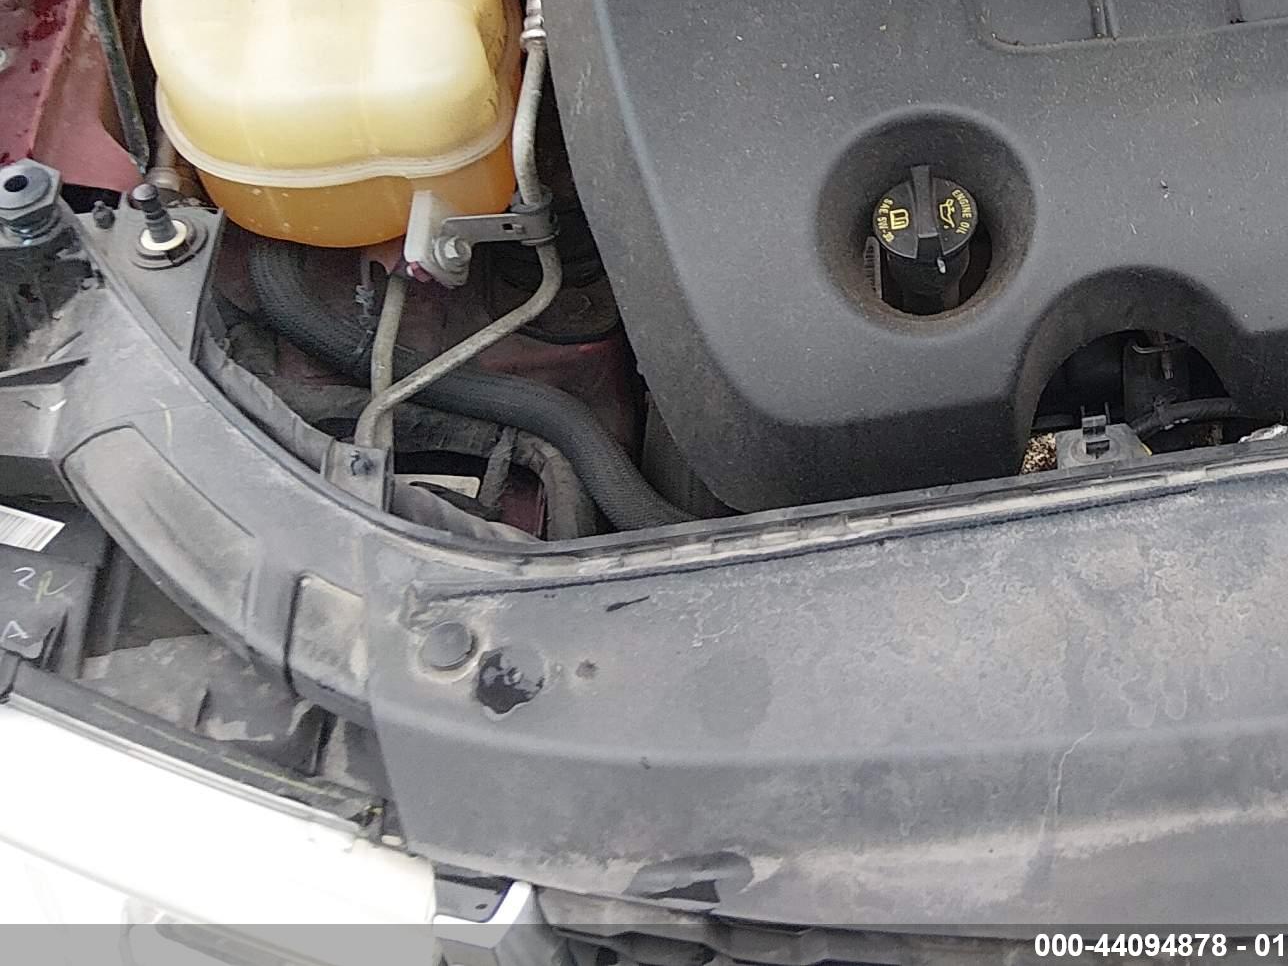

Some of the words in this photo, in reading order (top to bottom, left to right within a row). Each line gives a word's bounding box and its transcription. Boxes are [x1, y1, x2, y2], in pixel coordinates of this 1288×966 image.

[878, 198, 894, 214] SAE
[951, 189, 973, 219] ENGINE
[955, 221, 970, 235] OIL
